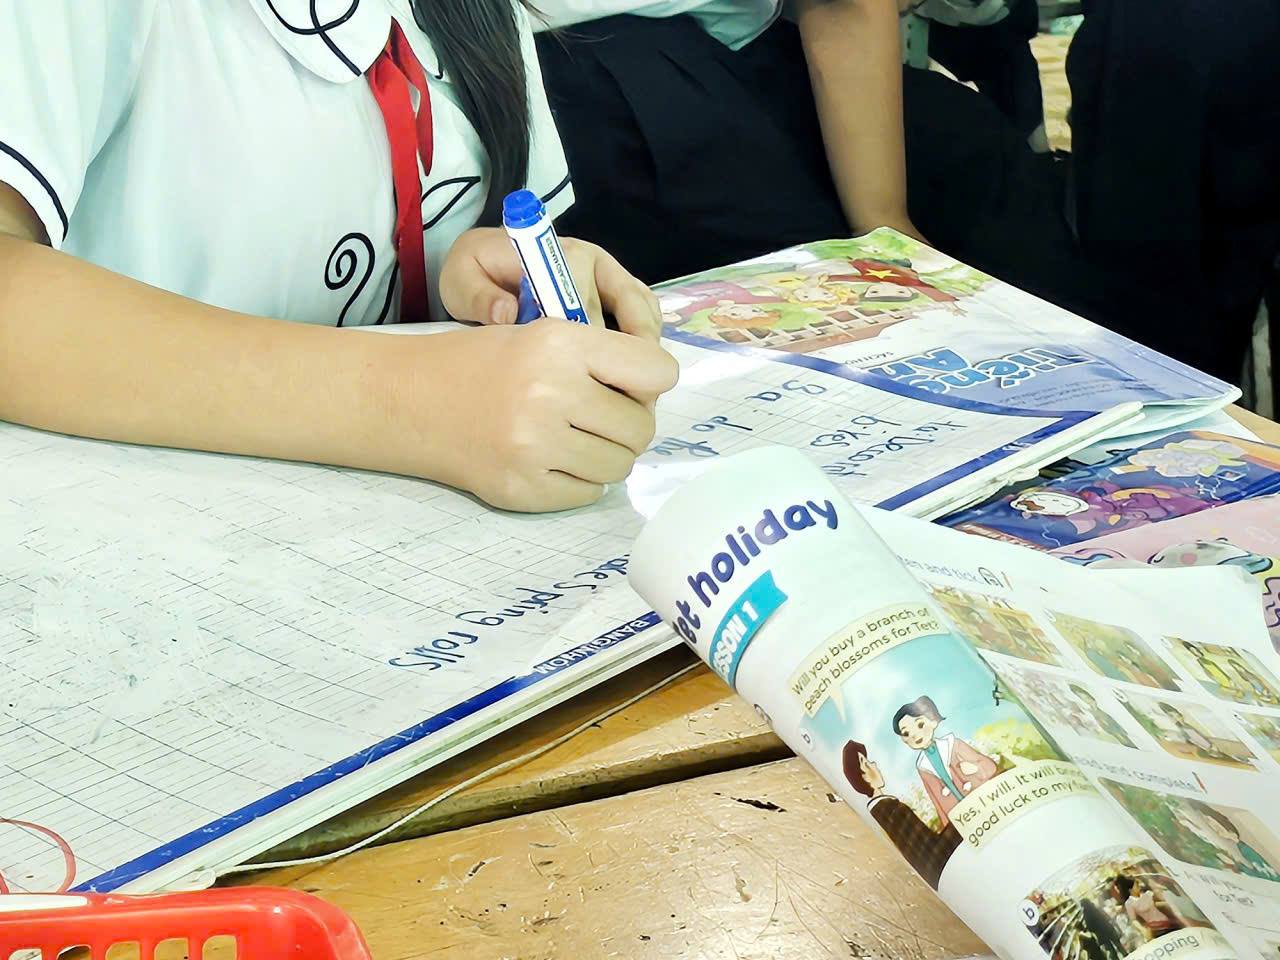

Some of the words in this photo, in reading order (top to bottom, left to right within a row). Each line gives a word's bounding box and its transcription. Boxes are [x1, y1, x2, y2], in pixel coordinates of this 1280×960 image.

[687, 499, 839, 608] holiday
[741, 600, 759, 622] 1
[792, 673, 811, 695] Will
[809, 655, 829, 678] you
[829, 635, 854, 656] buy
[856, 629, 866, 639] a
[865, 608, 916, 633] branch
[804, 676, 832, 713] peach
[830, 634, 891, 680] blossoms
[890, 625, 912, 640] for
[955, 806, 981, 826] Yes,
[987, 780, 1015, 802] will.
[1015, 774, 1029, 785] It
[1029, 765, 1054, 780] will
[968, 813, 1000, 848] good
[998, 794, 1032, 817] luck
[1031, 787, 1049, 798] to
[1051, 782, 1073, 793] my
[1022, 907, 1035, 919] b
